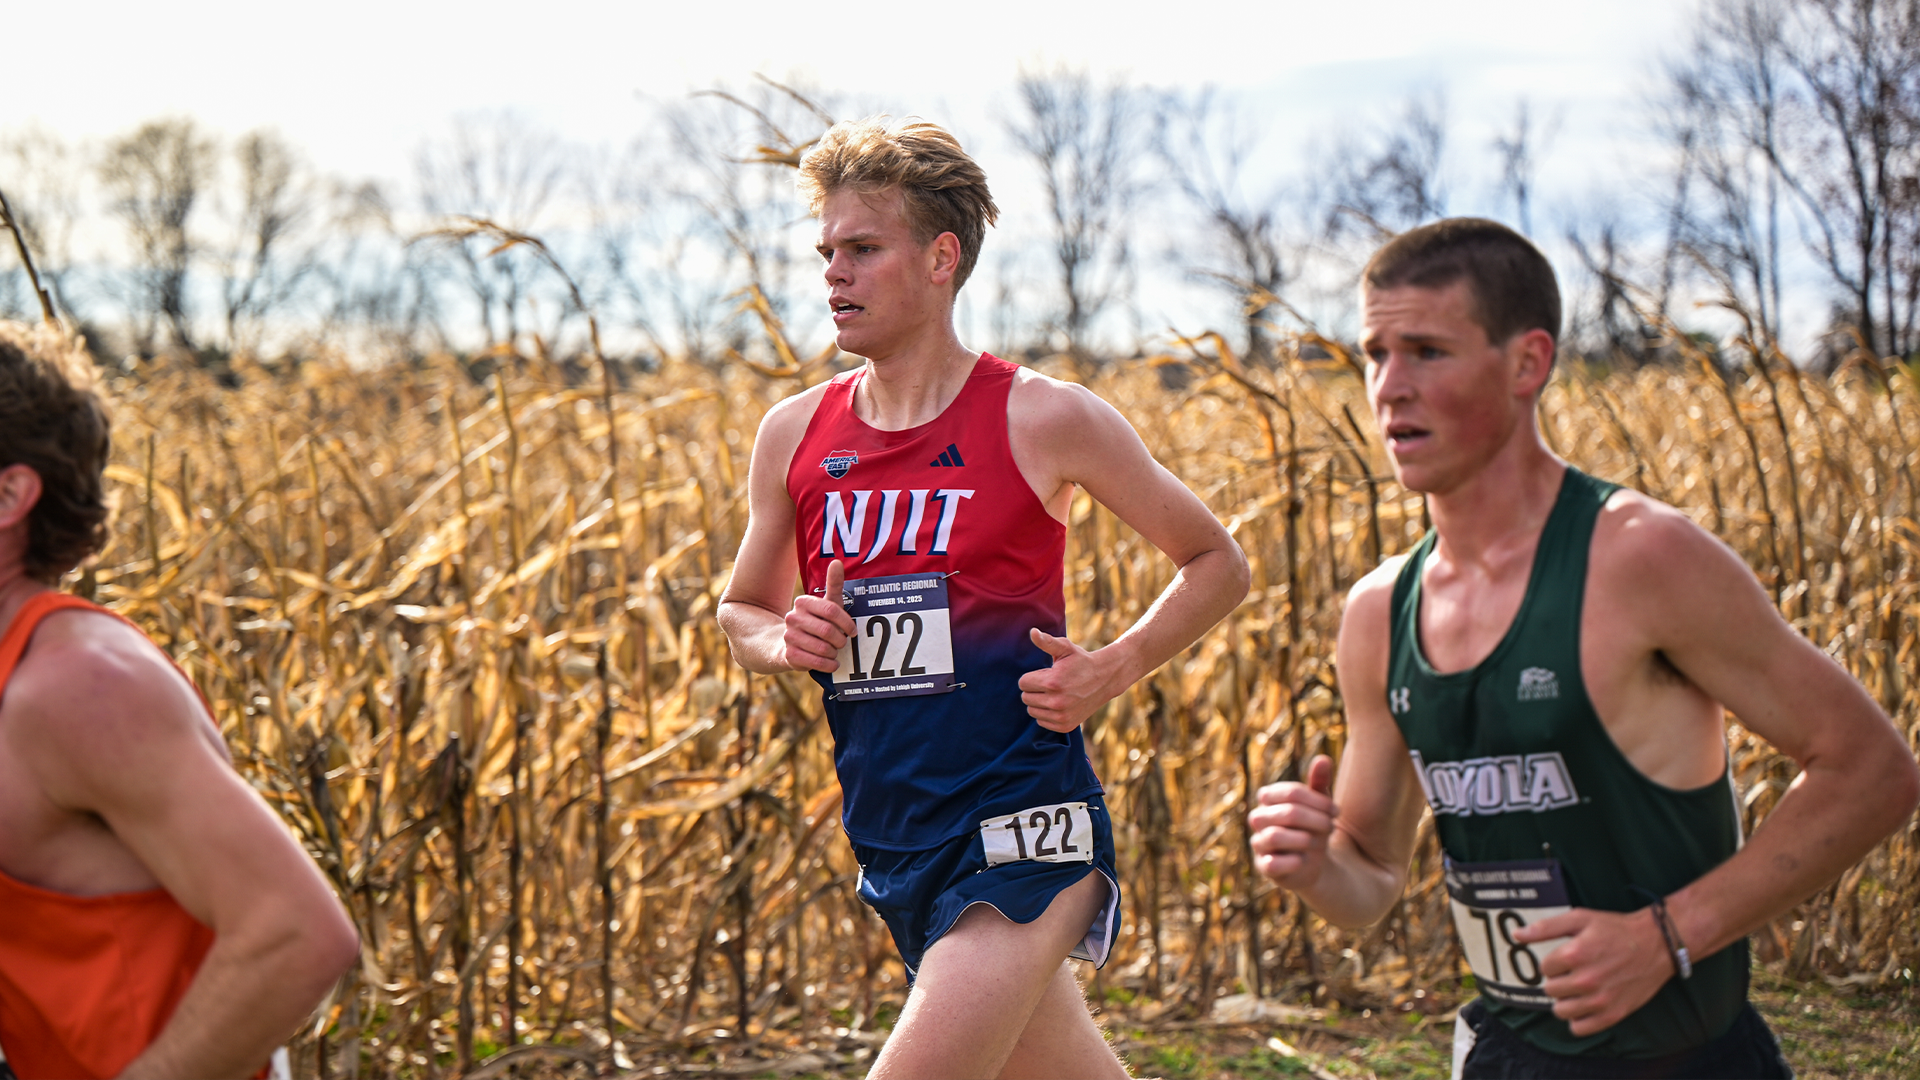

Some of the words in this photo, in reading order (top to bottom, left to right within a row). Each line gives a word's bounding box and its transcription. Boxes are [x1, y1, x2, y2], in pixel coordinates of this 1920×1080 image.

[820, 456, 858, 467] AMERICA
[827, 462, 849, 470] EAST
[820, 489, 975, 565] NJIT
[854, 582, 901, 596] MID-ATLANTIC
[902, 579, 938, 591] REGIONAL
[868, 599, 896, 607] NOVEMBER
[897, 596, 906, 604] 14,
[907, 595, 923, 603] 2025
[849, 612, 926, 681] 122
[1004, 807, 1078, 859] 122
[1469, 908, 1543, 986] 78
